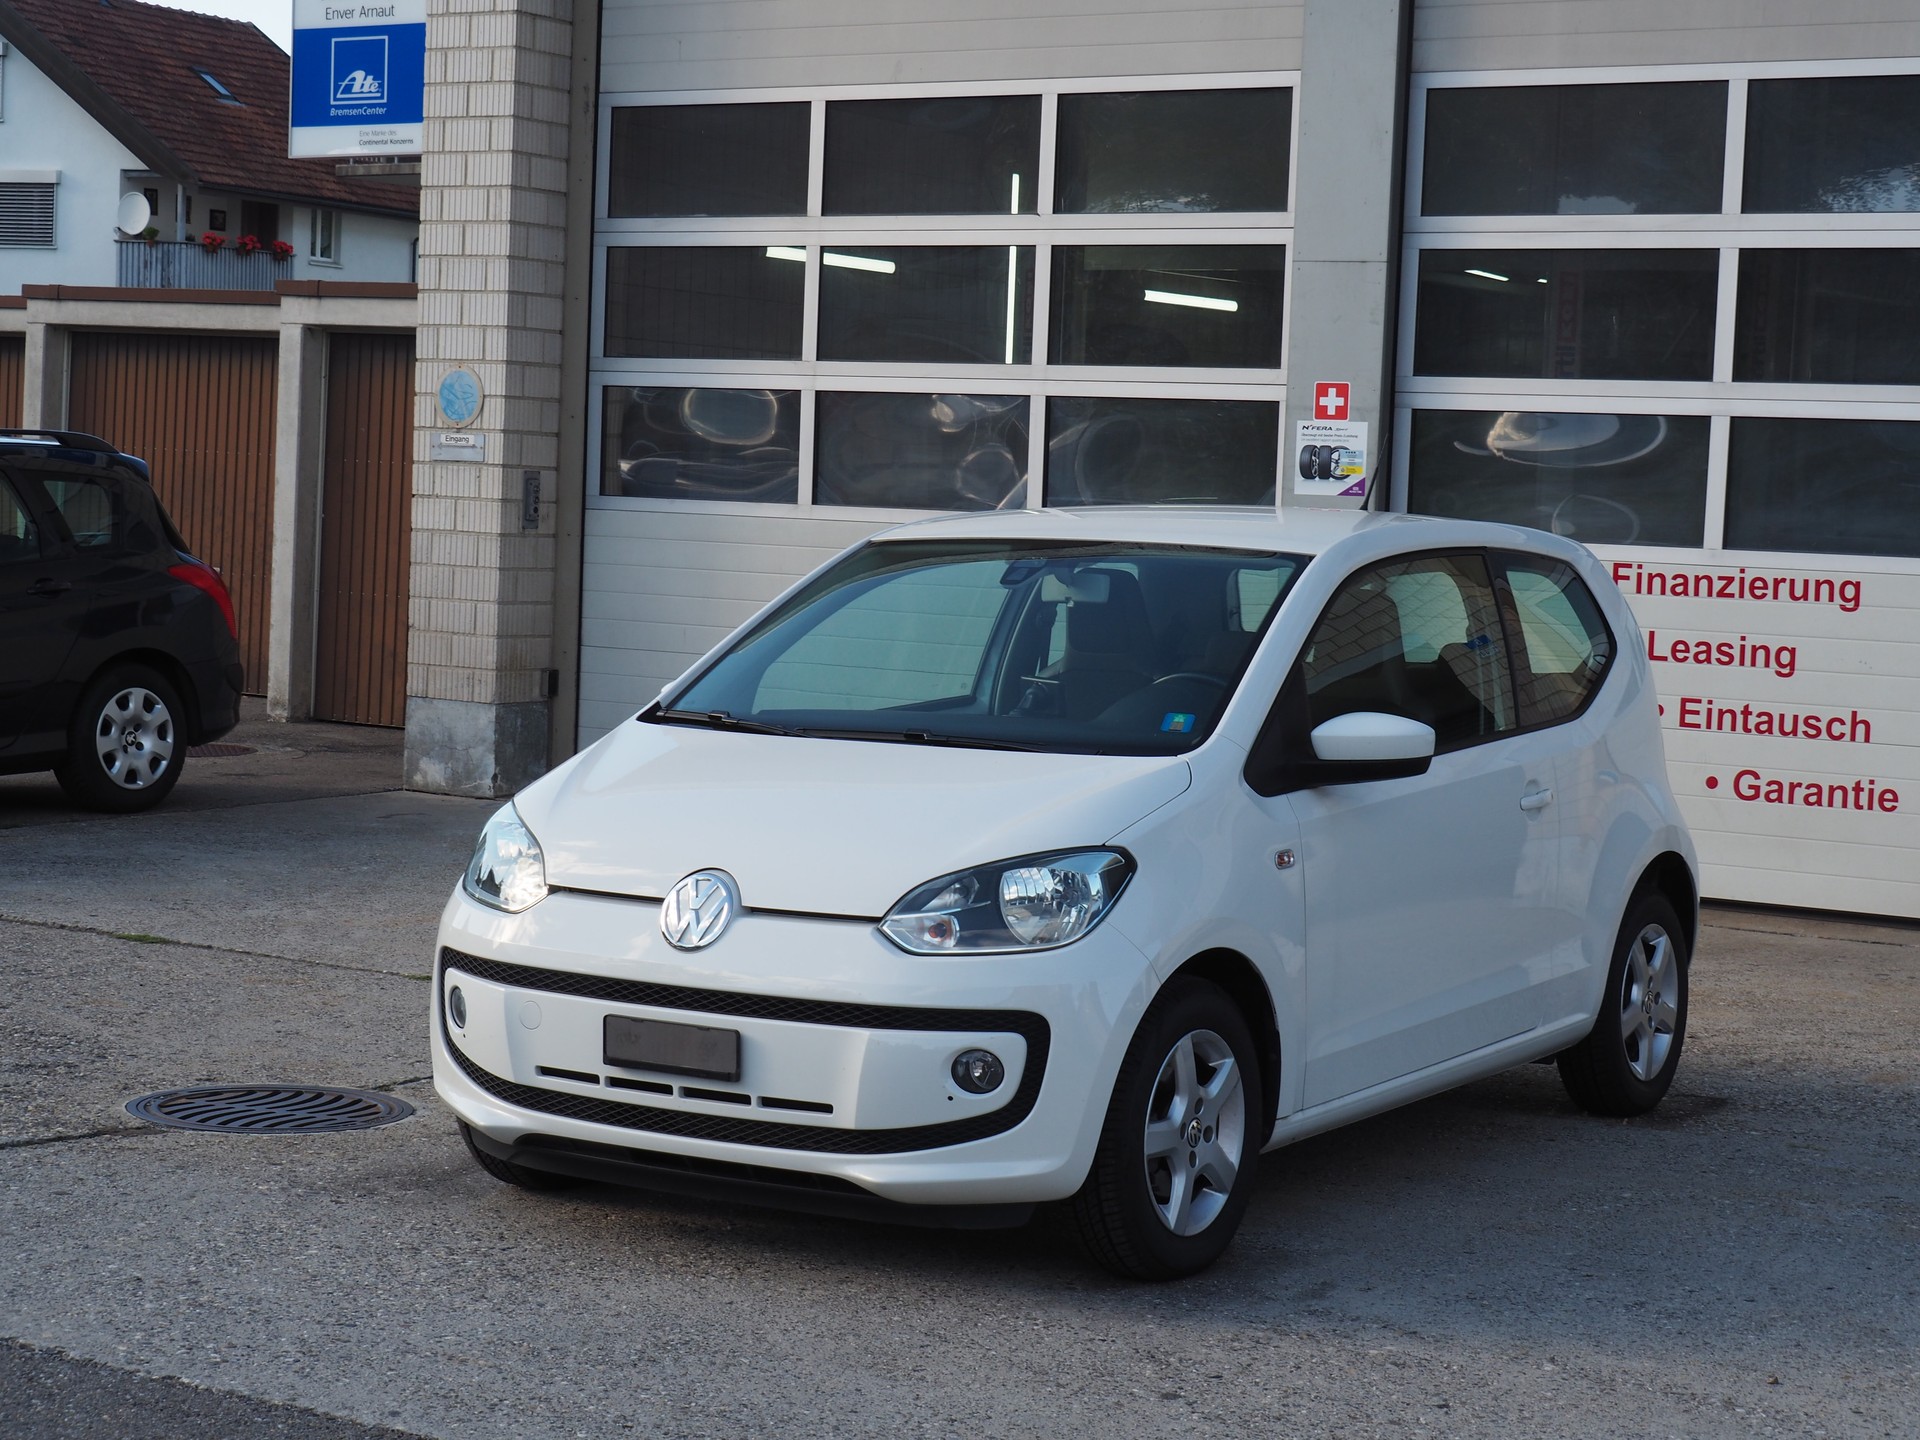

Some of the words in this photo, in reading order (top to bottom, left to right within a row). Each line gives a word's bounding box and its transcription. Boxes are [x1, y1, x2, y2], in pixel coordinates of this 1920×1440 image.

[326, 7, 355, 20] Enver
[359, 4, 395, 18] Arnaut
[330, 106, 387, 117] BremsenCenter
[359, 138, 388, 146] Continental
[445, 434, 470, 444] Eingang
[1612, 563, 1862, 613] Finanzierung
[1648, 630, 1797, 678] Leasing
[1679, 697, 1872, 743] Eintausch
[1733, 769, 1900, 813] Garantie
